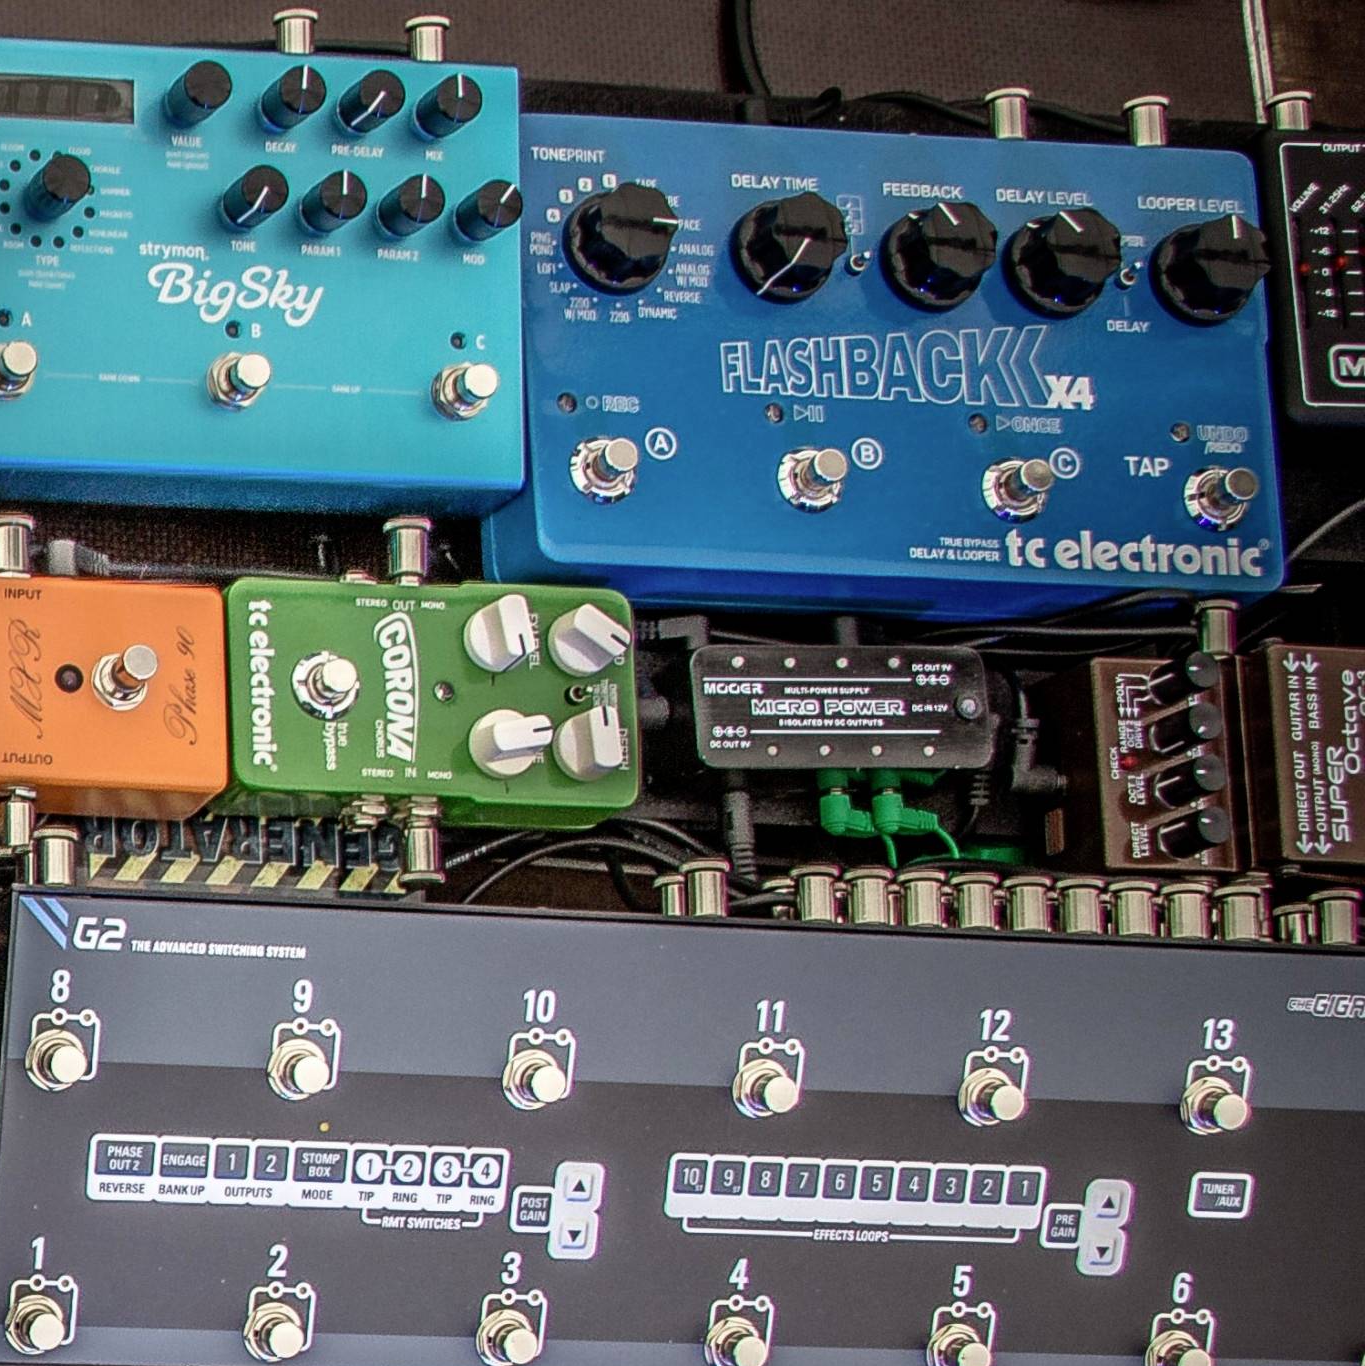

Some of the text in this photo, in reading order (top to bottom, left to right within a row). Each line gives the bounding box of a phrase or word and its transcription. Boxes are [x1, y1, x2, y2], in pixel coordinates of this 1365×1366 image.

[171, 135, 203, 148] VALUE
[265, 141, 297, 154] DECAY
[1322, 143, 1361, 153] OUTPUT
[331, 144, 384, 159] PRE-DELAY
[426, 150, 443, 162] MIX
[530, 146, 606, 164] TONEPRINT
[731, 174, 819, 191] DELAY TIME
[882, 182, 964, 200] FEEDBACK
[996, 188, 1093, 207] DELAY LEVEL
[1138, 196, 1244, 214] LOOPER LEVEL
[1289, 182, 1320, 213] VOLUME
[676, 218, 702, 232] PACE
[231, 240, 256, 253] TONE
[301, 244, 332, 257] PARAM
[377, 248, 409, 261] PARAM
[678, 243, 715, 257] ANALOG
[36, 255, 59, 267] TYPE
[463, 254, 485, 266] MOD
[675, 264, 710, 276] ANALOG
[147, 262, 324, 327] BigSky
[664, 291, 702, 304] REVERSE
[20, 312, 32, 328] A
[638, 307, 678, 320] DYNAMIC
[250, 323, 262, 339] B
[1106, 319, 1150, 333] DELAY
[475, 334, 487, 351] C
[720, 325, 1024, 407] FLASHBACK
[1044, 374, 1096, 411] X4
[602, 395, 640, 413] REC
[1010, 417, 1062, 434] ONCE
[1197, 425, 1249, 443] UNDO
[1124, 456, 1170, 477] TAP
[939, 536, 1000, 549] TRUE BYPASS
[909, 547, 1001, 563] DELAY LOOPER
[1005, 528, 1264, 577] tc electronic
[3, 587, 43, 601] INPUT
[355, 597, 388, 608] STEREO
[392, 599, 416, 612] OUT
[420, 600, 446, 610] MONO
[8, 618, 45, 740] MXR
[164, 625, 198, 746] Phase 90
[248, 599, 276, 767] tc electronic
[376, 617, 415, 763] CORONA
[703, 682, 764, 696] MOOER
[784, 685, 871, 696] MULTI-POWER SUPPLY
[751, 698, 906, 717] MICRO POWER
[1290, 691, 1303, 741] GUITAR
[1307, 691, 1320, 729] BASS
[845, 719, 885, 728] OUTPUTS
[337, 722, 350, 748] true
[324, 722, 336, 771] bypass
[2, 752, 54, 766] OUTPUT
[1110, 746, 1120, 780] CHECK
[1326, 669, 1362, 842] SUPER Octave
[361, 768, 394, 779] STEREO
[427, 770, 452, 780] MONO
[1136, 773, 1146, 806] LEVEL
[1293, 750, 1309, 832] DIRECT OUT
[1313, 779, 1327, 832] OUTPUT
[1132, 821, 1142, 859] DIRECT
[1140, 823, 1150, 857] LEVEL
[72, 916, 307, 960] G2 THE ADVANCED SWITCHING SYSTEM
[49, 969, 71, 1004] 8
[292, 978, 314, 1013] 9
[522, 990, 557, 1024] 10
[754, 1000, 786, 1034] 11
[980, 1009, 1013, 1043] 12
[1201, 1018, 1235, 1052] 13
[107, 1144, 143, 1159] PHASE
[301, 1151, 341, 1165] STOMP
[109, 1158, 132, 1171] OUT
[162, 1153, 207, 1168] ENGAGE
[266, 1154, 278, 1173] 2
[308, 1165, 331, 1178] BOX
[682, 1167, 700, 1187] 10
[723, 1169, 735, 1188] 9
[760, 1170, 772, 1189] 8
[99, 1181, 146, 1195] REVERSE
[798, 1171, 810, 1190] 7
[835, 1172, 846, 1192] 6
[871, 1173, 883, 1193] 5
[907, 1175, 920, 1194] 4
[945, 1176, 957, 1195] 3
[1201, 1182, 1235, 1196] TUNER
[158, 1183, 206, 1197] BANK UP
[224, 1185, 273, 1200] OUTPUTS
[301, 1188, 334, 1201] MODE
[358, 1190, 375, 1202] TIP
[392, 1191, 418, 1204] RING
[436, 1192, 453, 1205] TIP
[469, 1193, 496, 1206] RING
[521, 1196, 549, 1209] POST
[381, 1215, 462, 1231] RMT SWITCHES
[519, 1209, 548, 1222] GAIN
[1054, 1213, 1075, 1226] PRE
[812, 1227, 890, 1243] EFFECTS LOOPS
[1050, 1226, 1077, 1239] GAIN
[29, 1236, 47, 1271] 1
[266, 1243, 290, 1278] 2
[500, 1250, 523, 1286] 3
[728, 1257, 750, 1291] 4
[953, 1264, 974, 1297] 5
[1172, 1271, 1195, 1305] 6
